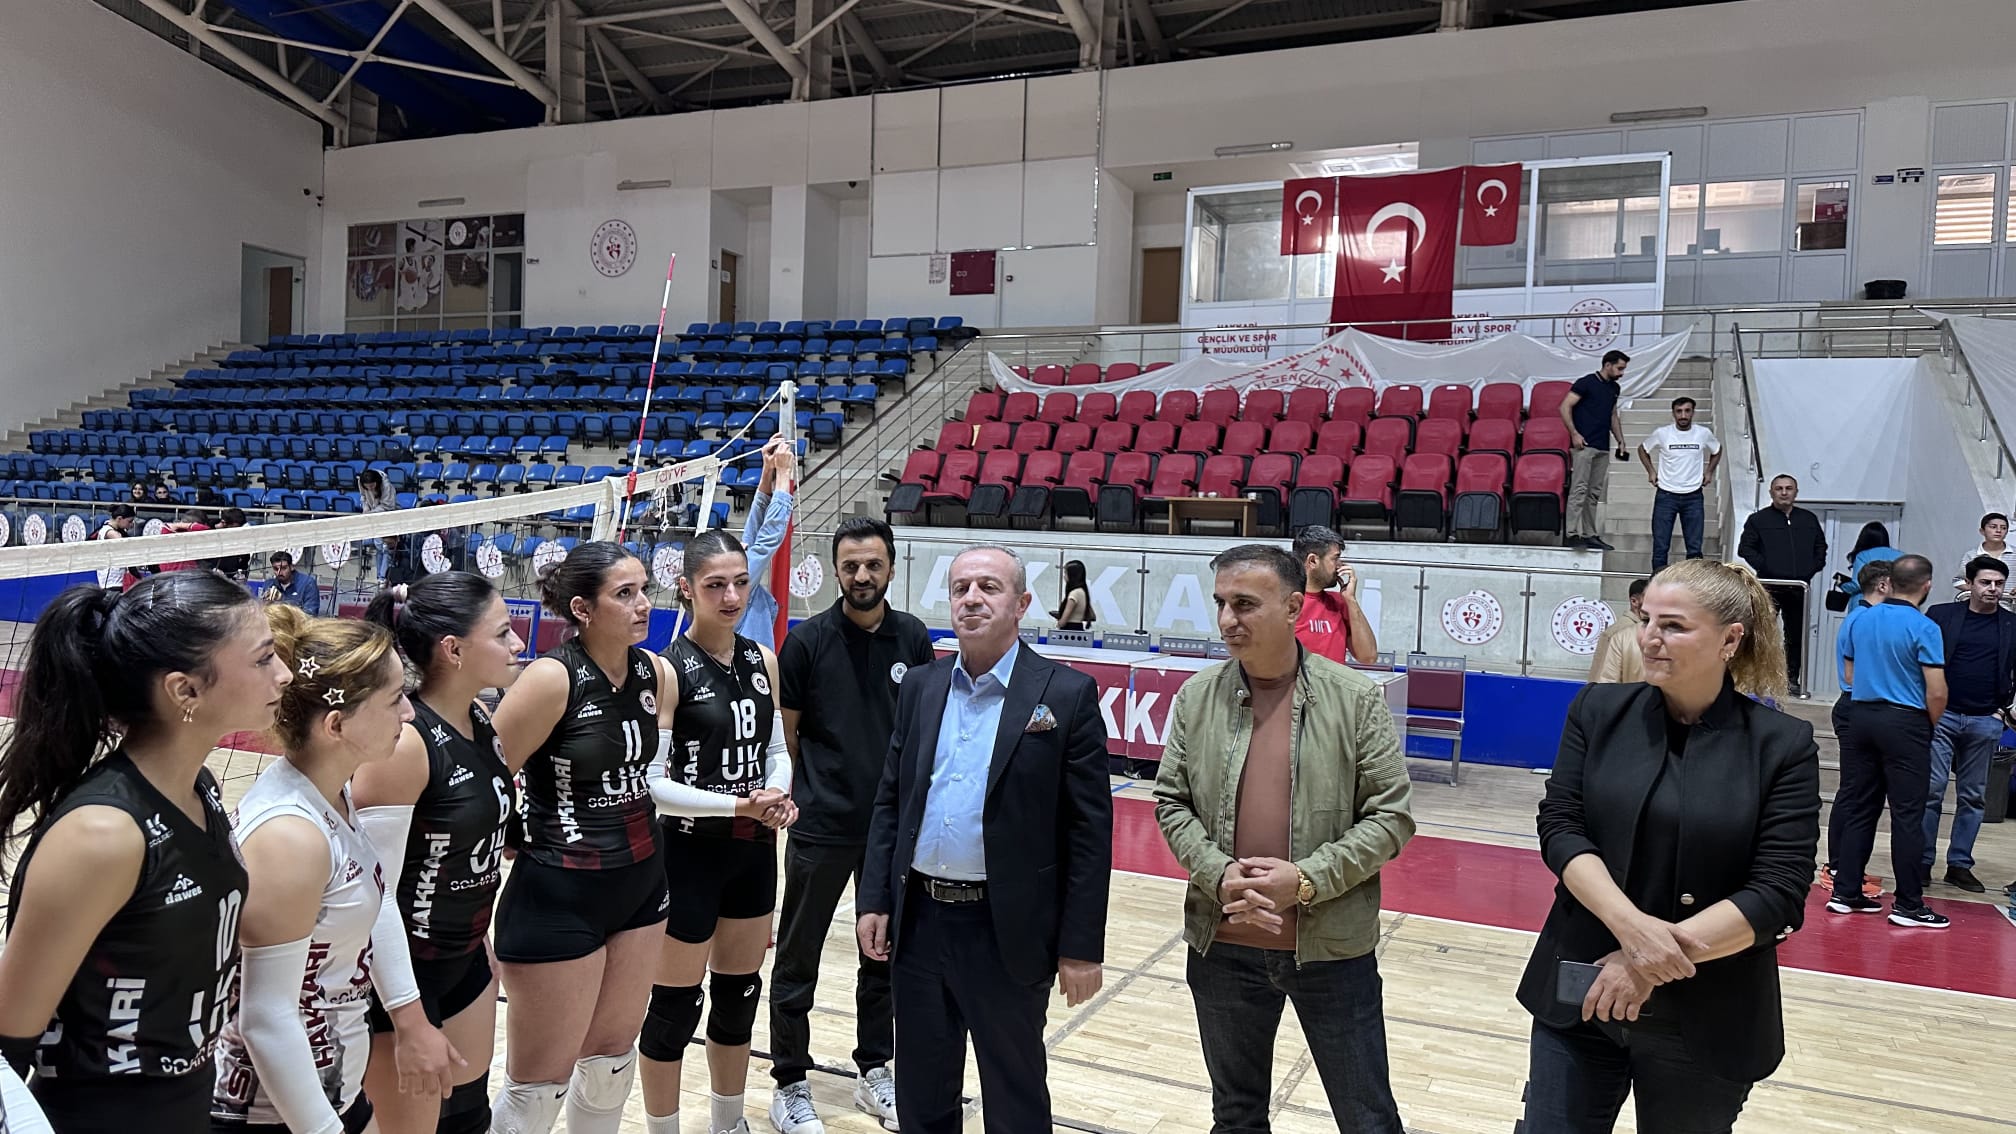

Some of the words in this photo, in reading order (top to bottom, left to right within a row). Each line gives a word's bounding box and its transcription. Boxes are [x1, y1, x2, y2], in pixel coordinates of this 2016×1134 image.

[1197, 332, 1237, 345] GENÇLİK
[1238, 334, 1252, 343] VE
[1252, 333, 1278, 343] SPOR
[1484, 323, 1512, 333] SPOR
[622, 719, 643, 763] 11
[730, 698, 757, 741] 18
[602, 763, 648, 796] UK
[721, 742, 762, 781] UK
[492, 775, 510, 825] 6
[550, 755, 584, 845] HAKKARİ
[588, 791, 633, 809] SOLAR
[412, 832, 451, 939] HAKKARİ
[216, 888, 242, 972] 10
